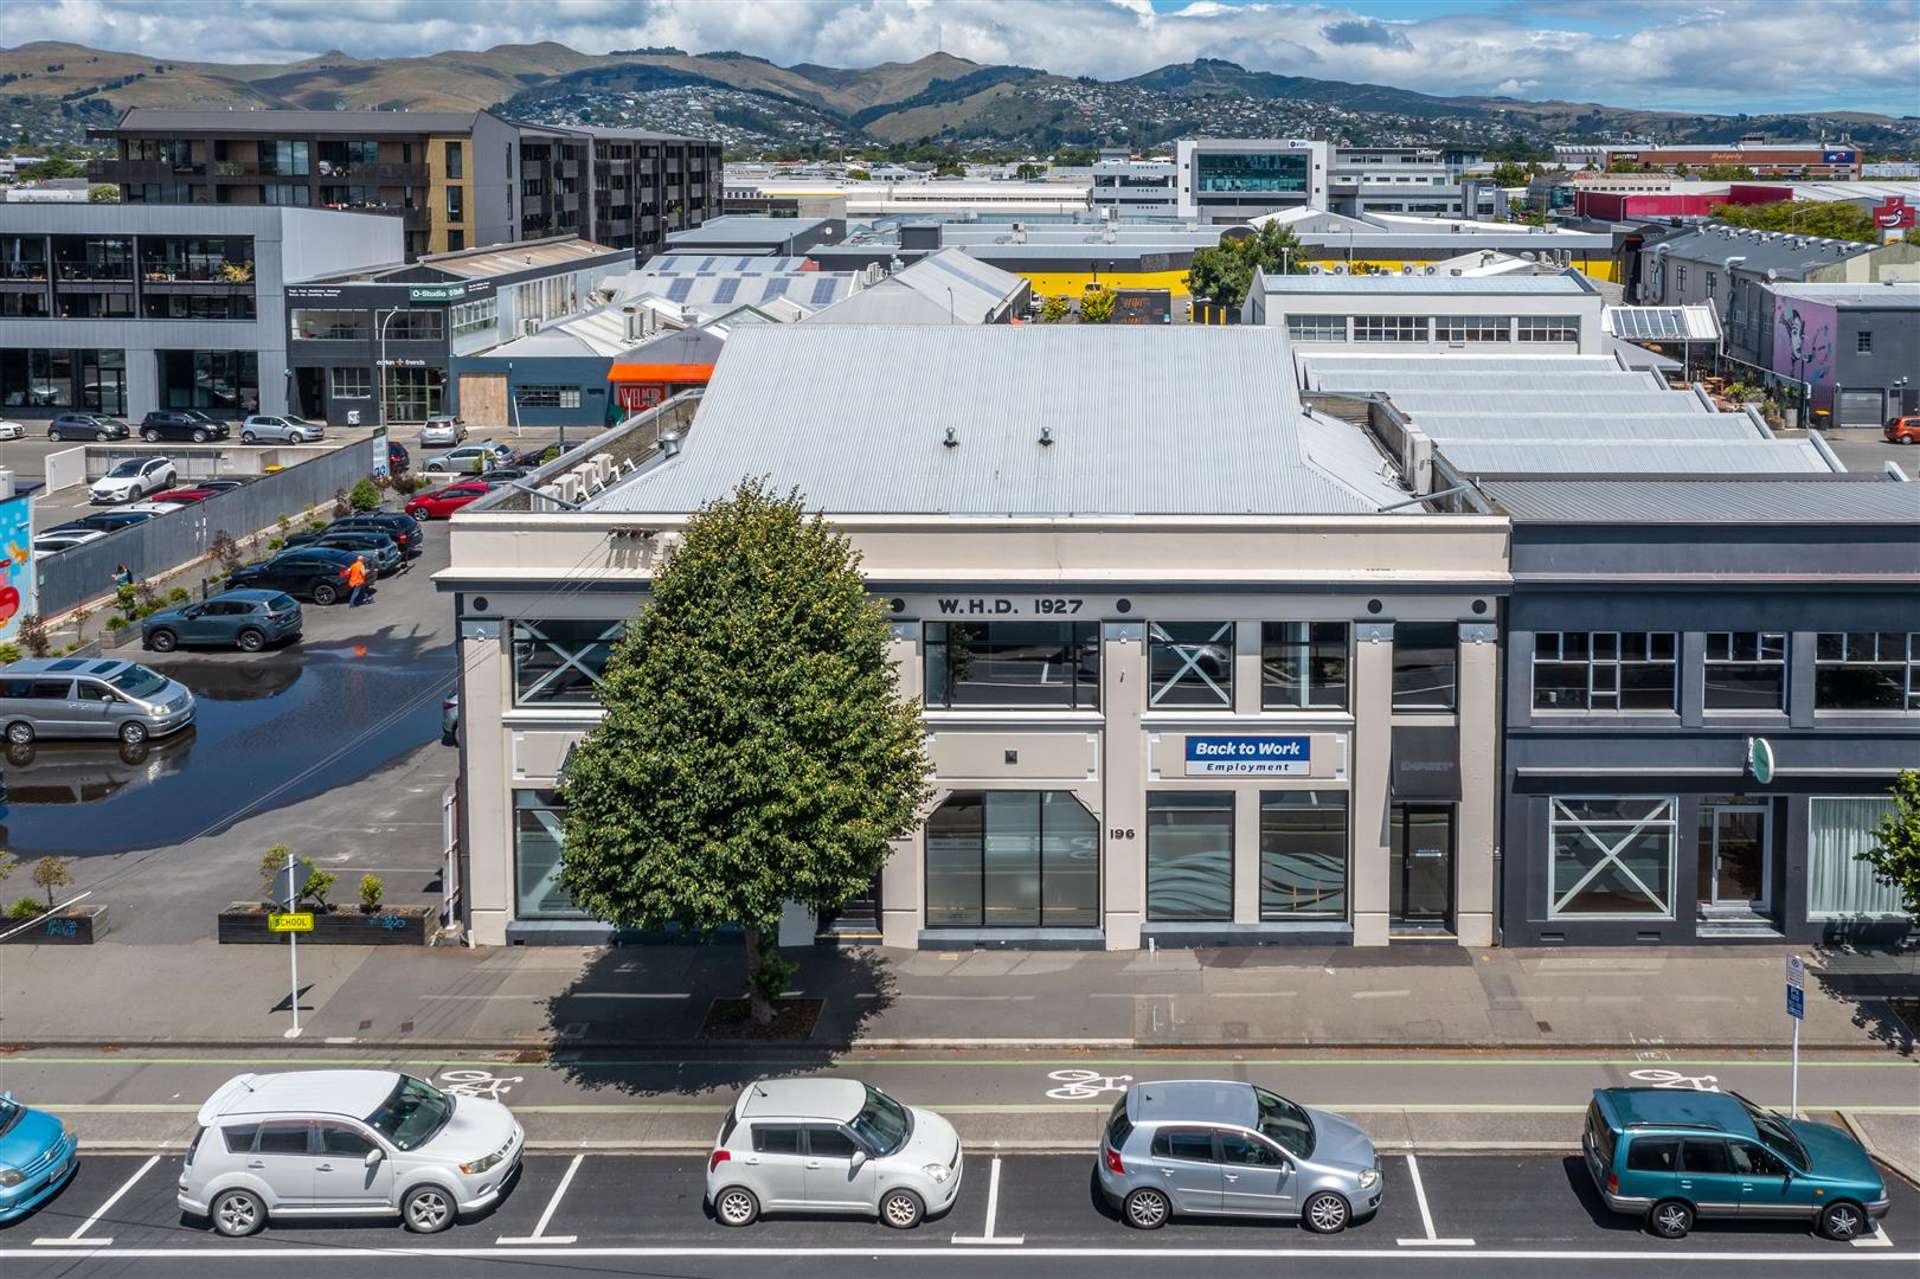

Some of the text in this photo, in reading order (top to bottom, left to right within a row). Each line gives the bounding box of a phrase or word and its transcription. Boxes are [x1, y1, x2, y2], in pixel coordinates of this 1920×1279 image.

[938, 599, 1084, 614] W.H.D. 1927
[1195, 741, 1300, 755] Back to Work
[1206, 762, 1289, 773] Employment
[1110, 828, 1136, 840] 196
[274, 917, 309, 928] SCHOOL
